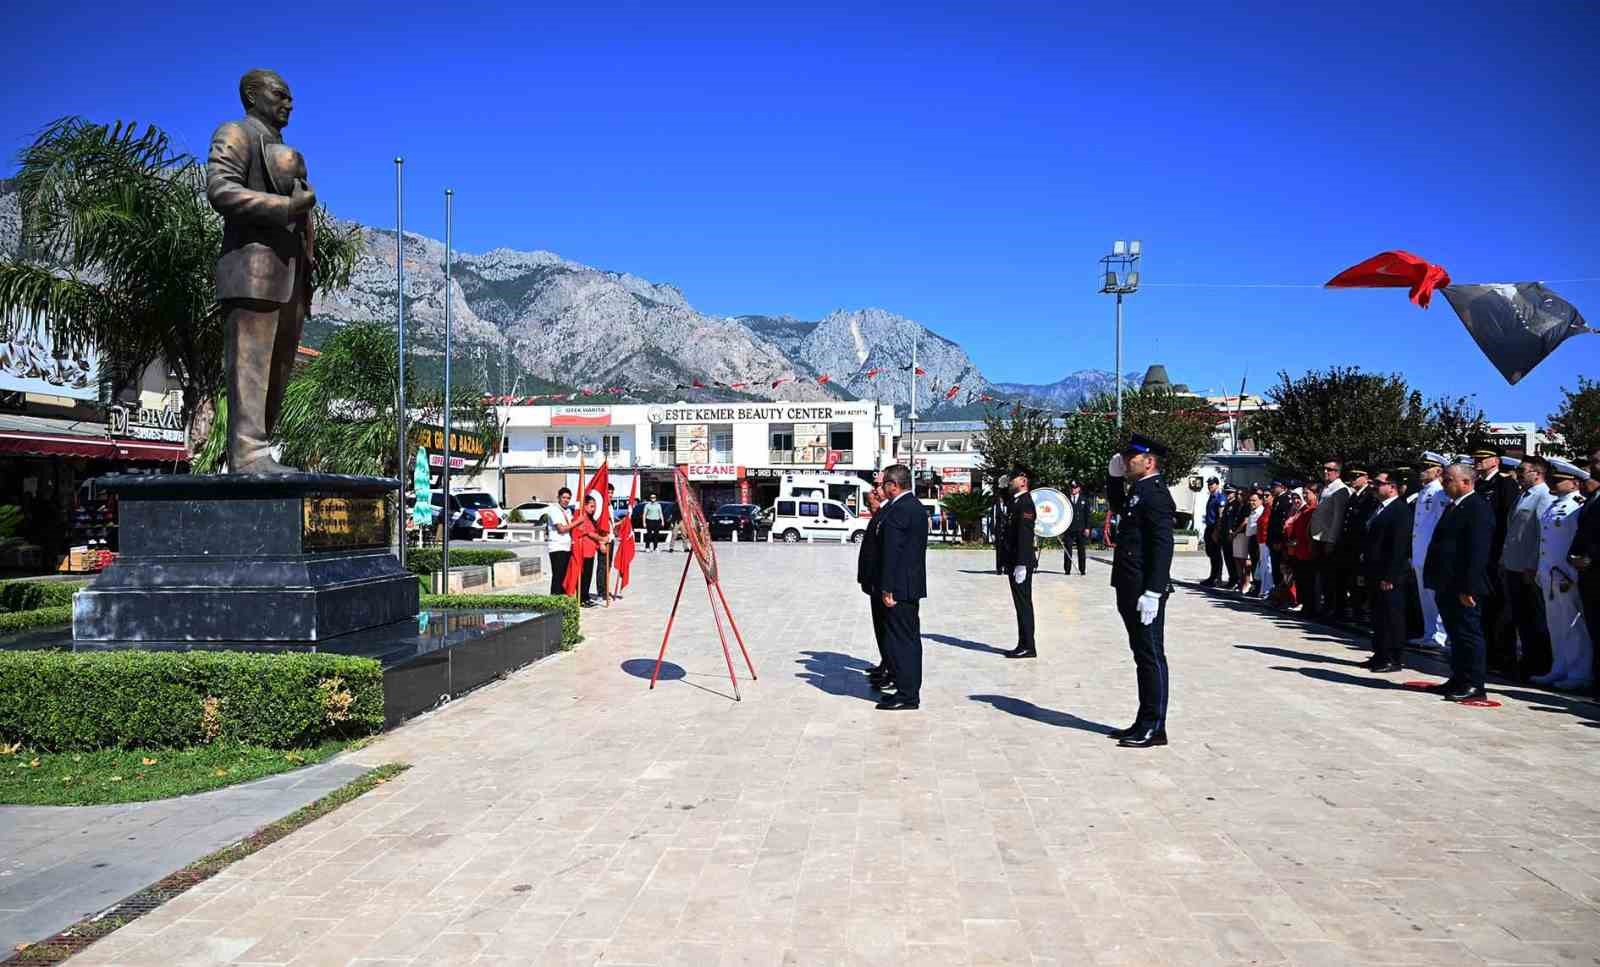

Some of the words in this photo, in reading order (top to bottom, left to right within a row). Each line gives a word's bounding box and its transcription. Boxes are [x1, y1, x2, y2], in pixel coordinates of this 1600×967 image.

[139, 406, 180, 429] DIVA
[665, 408, 693, 420] ESTE
[695, 408, 735, 420] KEMER
[738, 407, 784, 420] BEAUTY
[787, 407, 833, 419] CENTER
[689, 465, 735, 475] ECZANE
